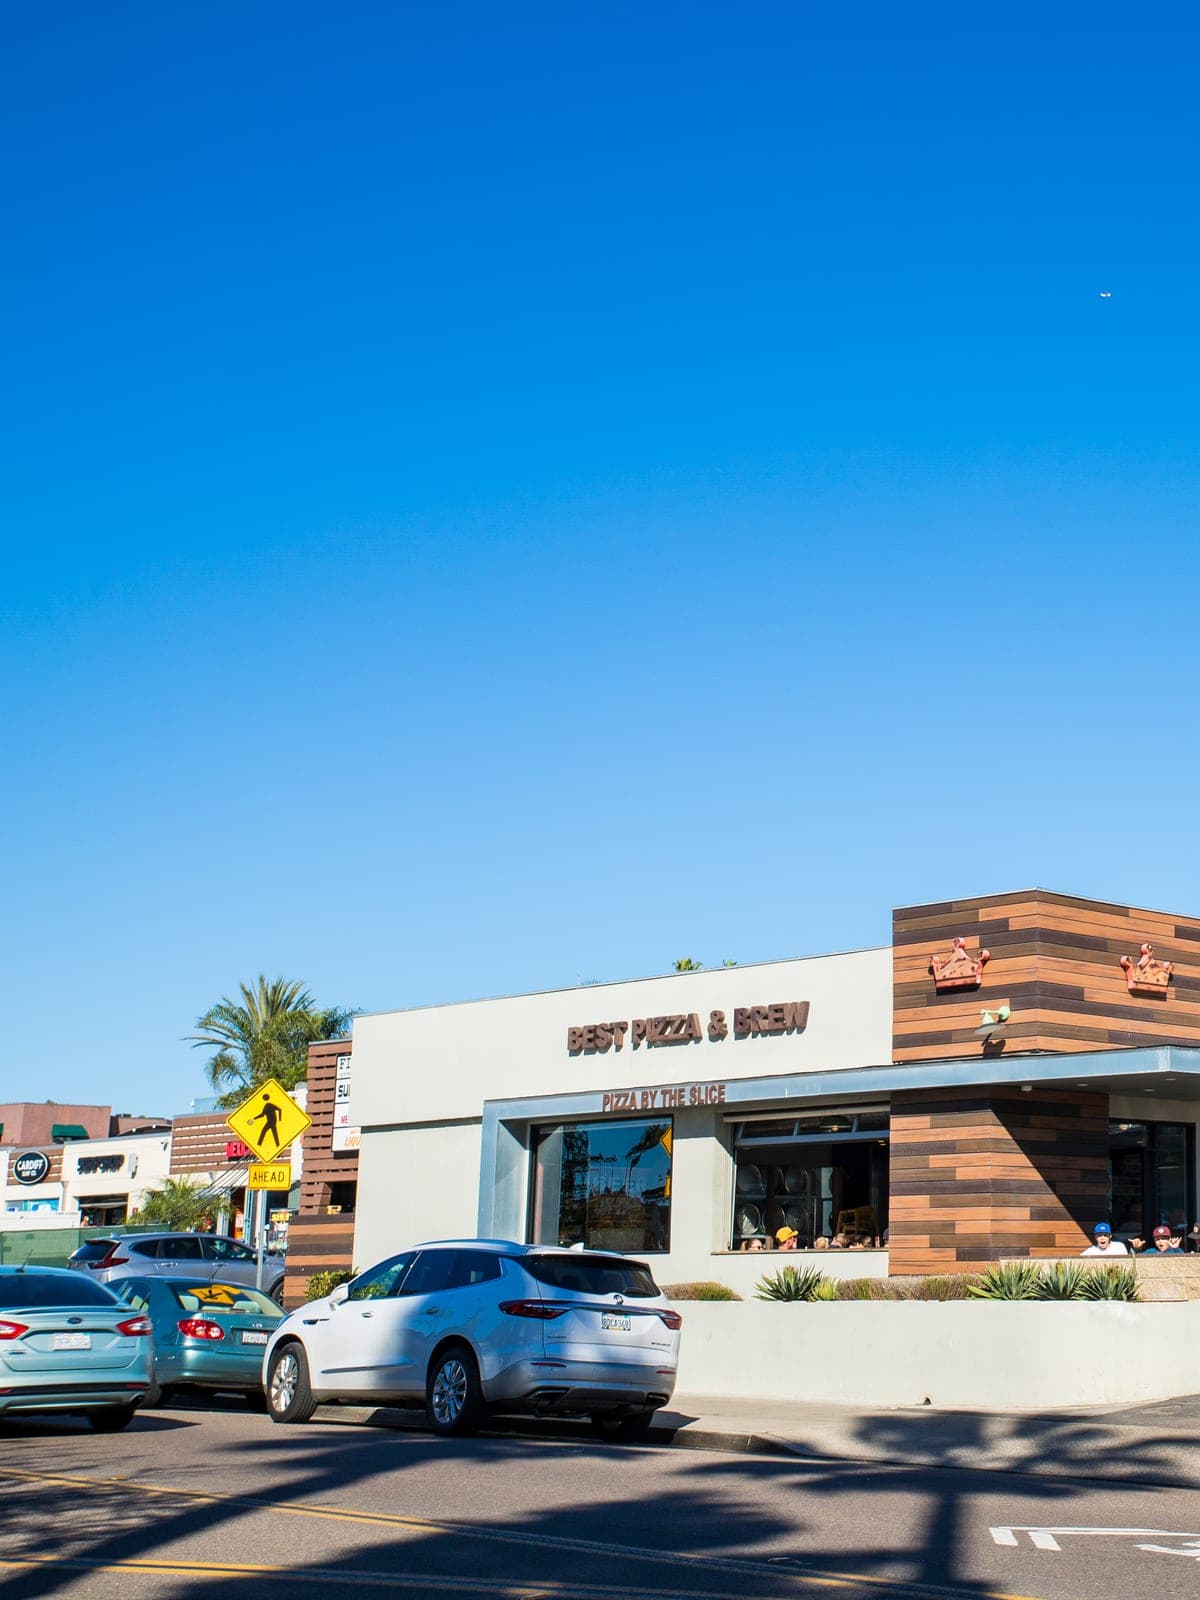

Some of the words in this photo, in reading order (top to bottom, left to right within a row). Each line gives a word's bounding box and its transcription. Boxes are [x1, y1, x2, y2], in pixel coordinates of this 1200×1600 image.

[567, 1021, 628, 1053] BEST
[632, 1013, 703, 1046] PIZZA
[707, 1010, 729, 1038] &
[734, 1001, 810, 1034] BREW
[602, 1091, 637, 1112] PIZZA
[641, 1089, 658, 1109] BY
[661, 1087, 685, 1107] THE
[689, 1084, 727, 1105] SLICE
[17, 1159, 43, 1170] CARDIFF
[253, 1171, 285, 1183] AHEAD
